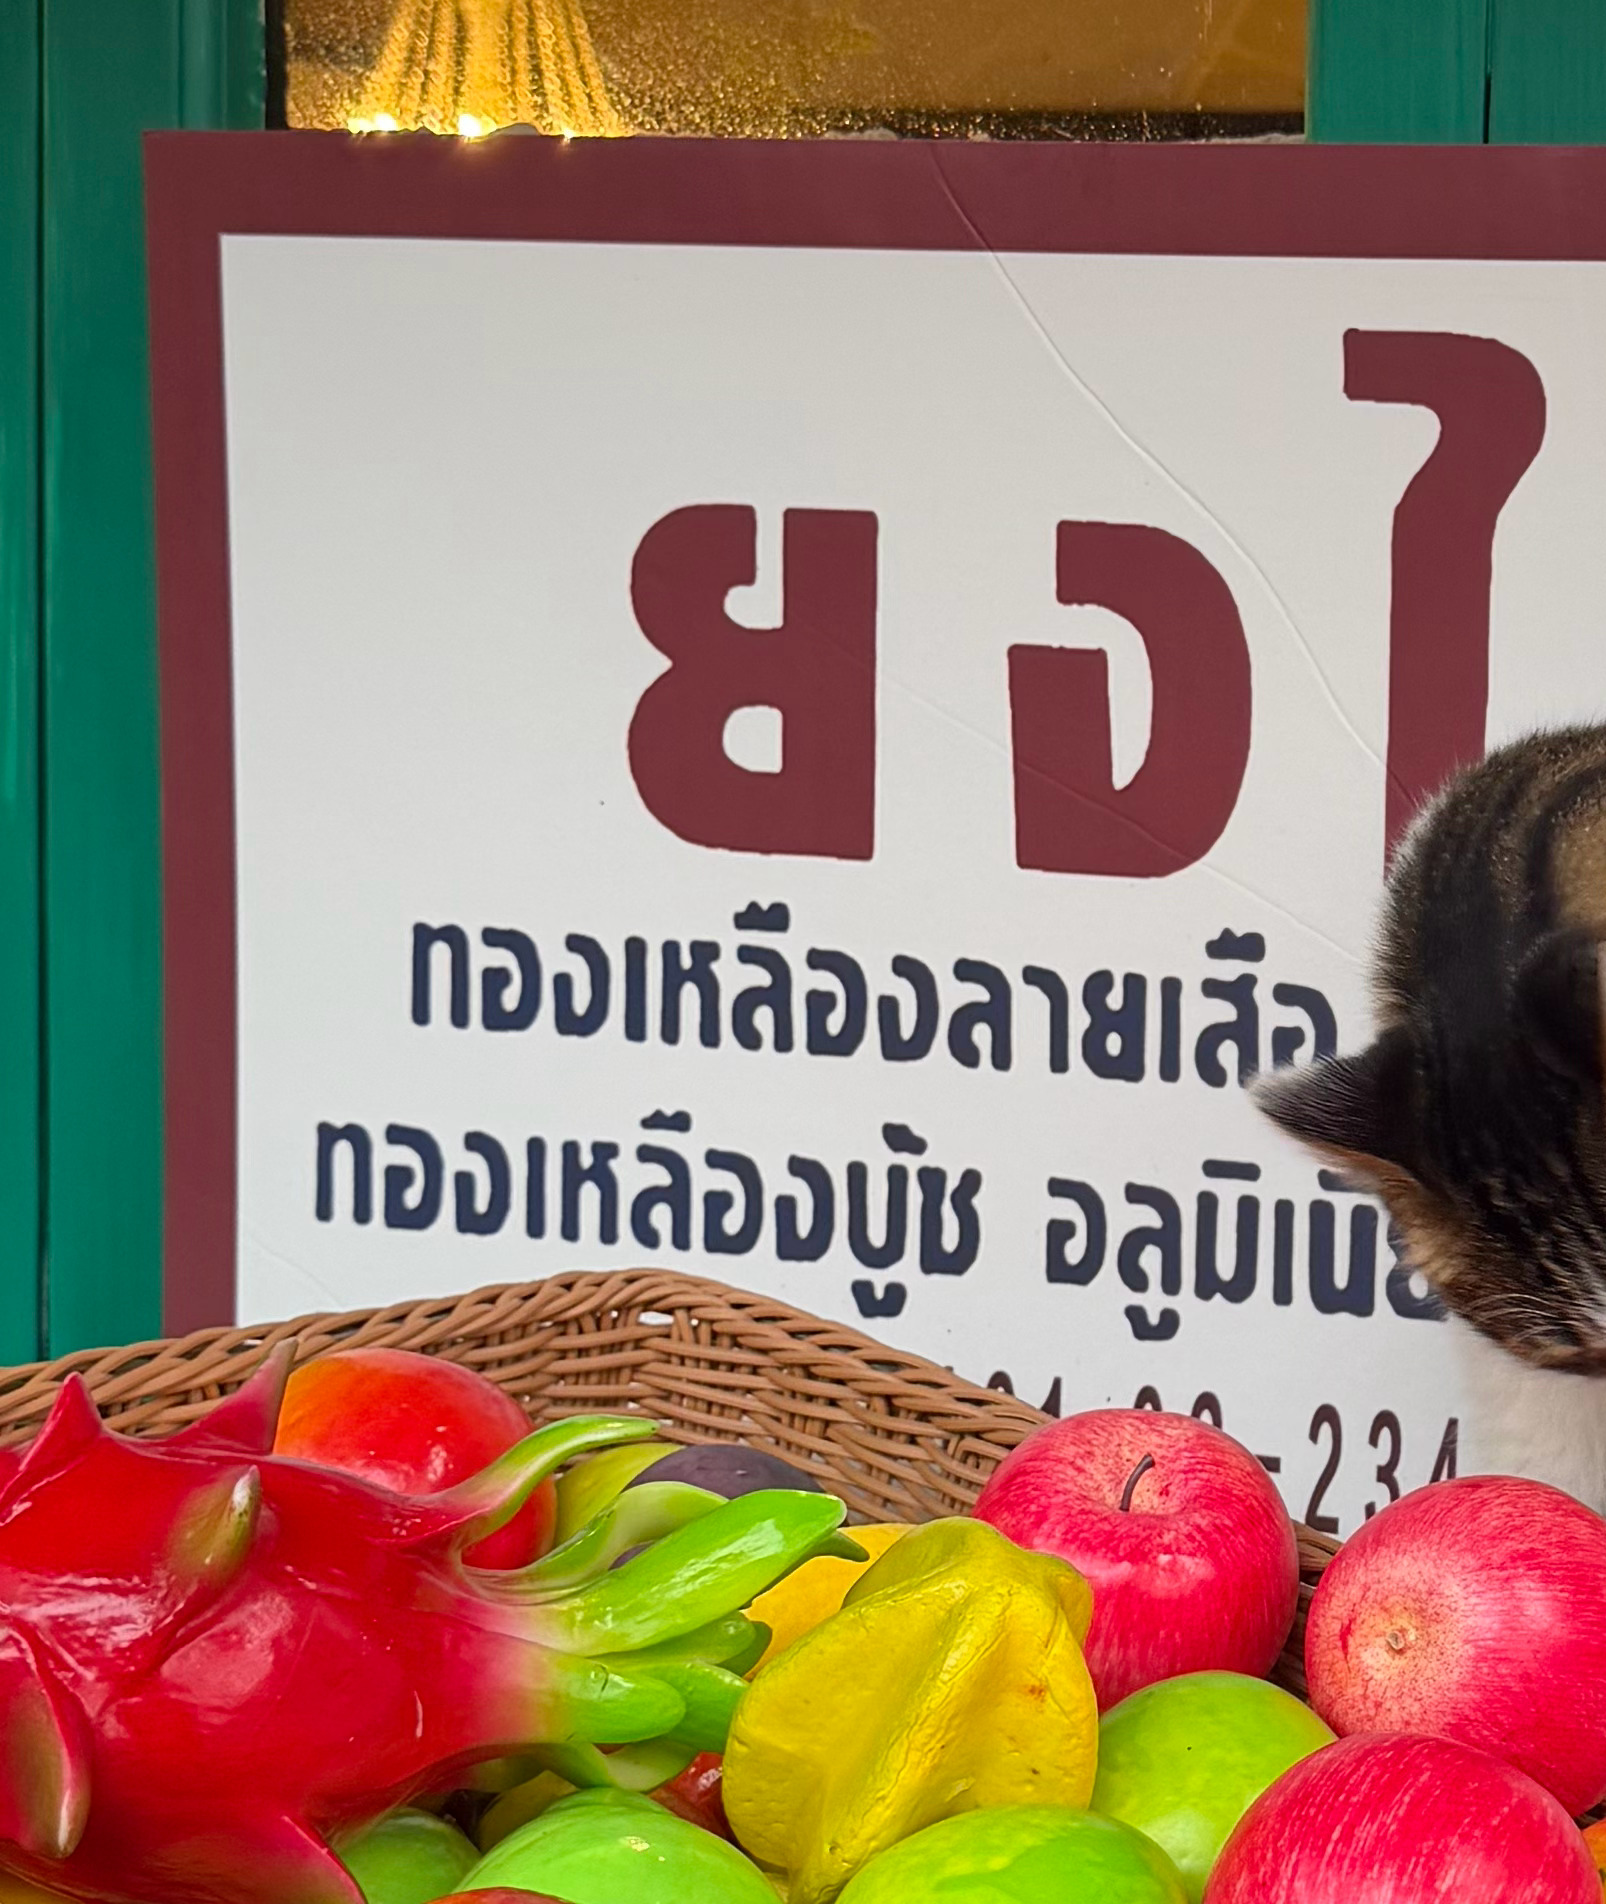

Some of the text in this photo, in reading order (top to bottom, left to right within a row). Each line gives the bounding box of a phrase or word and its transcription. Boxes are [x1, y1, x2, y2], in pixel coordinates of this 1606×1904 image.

[411, 901, 1339, 1089] ทองเหลืองลายเสือ
